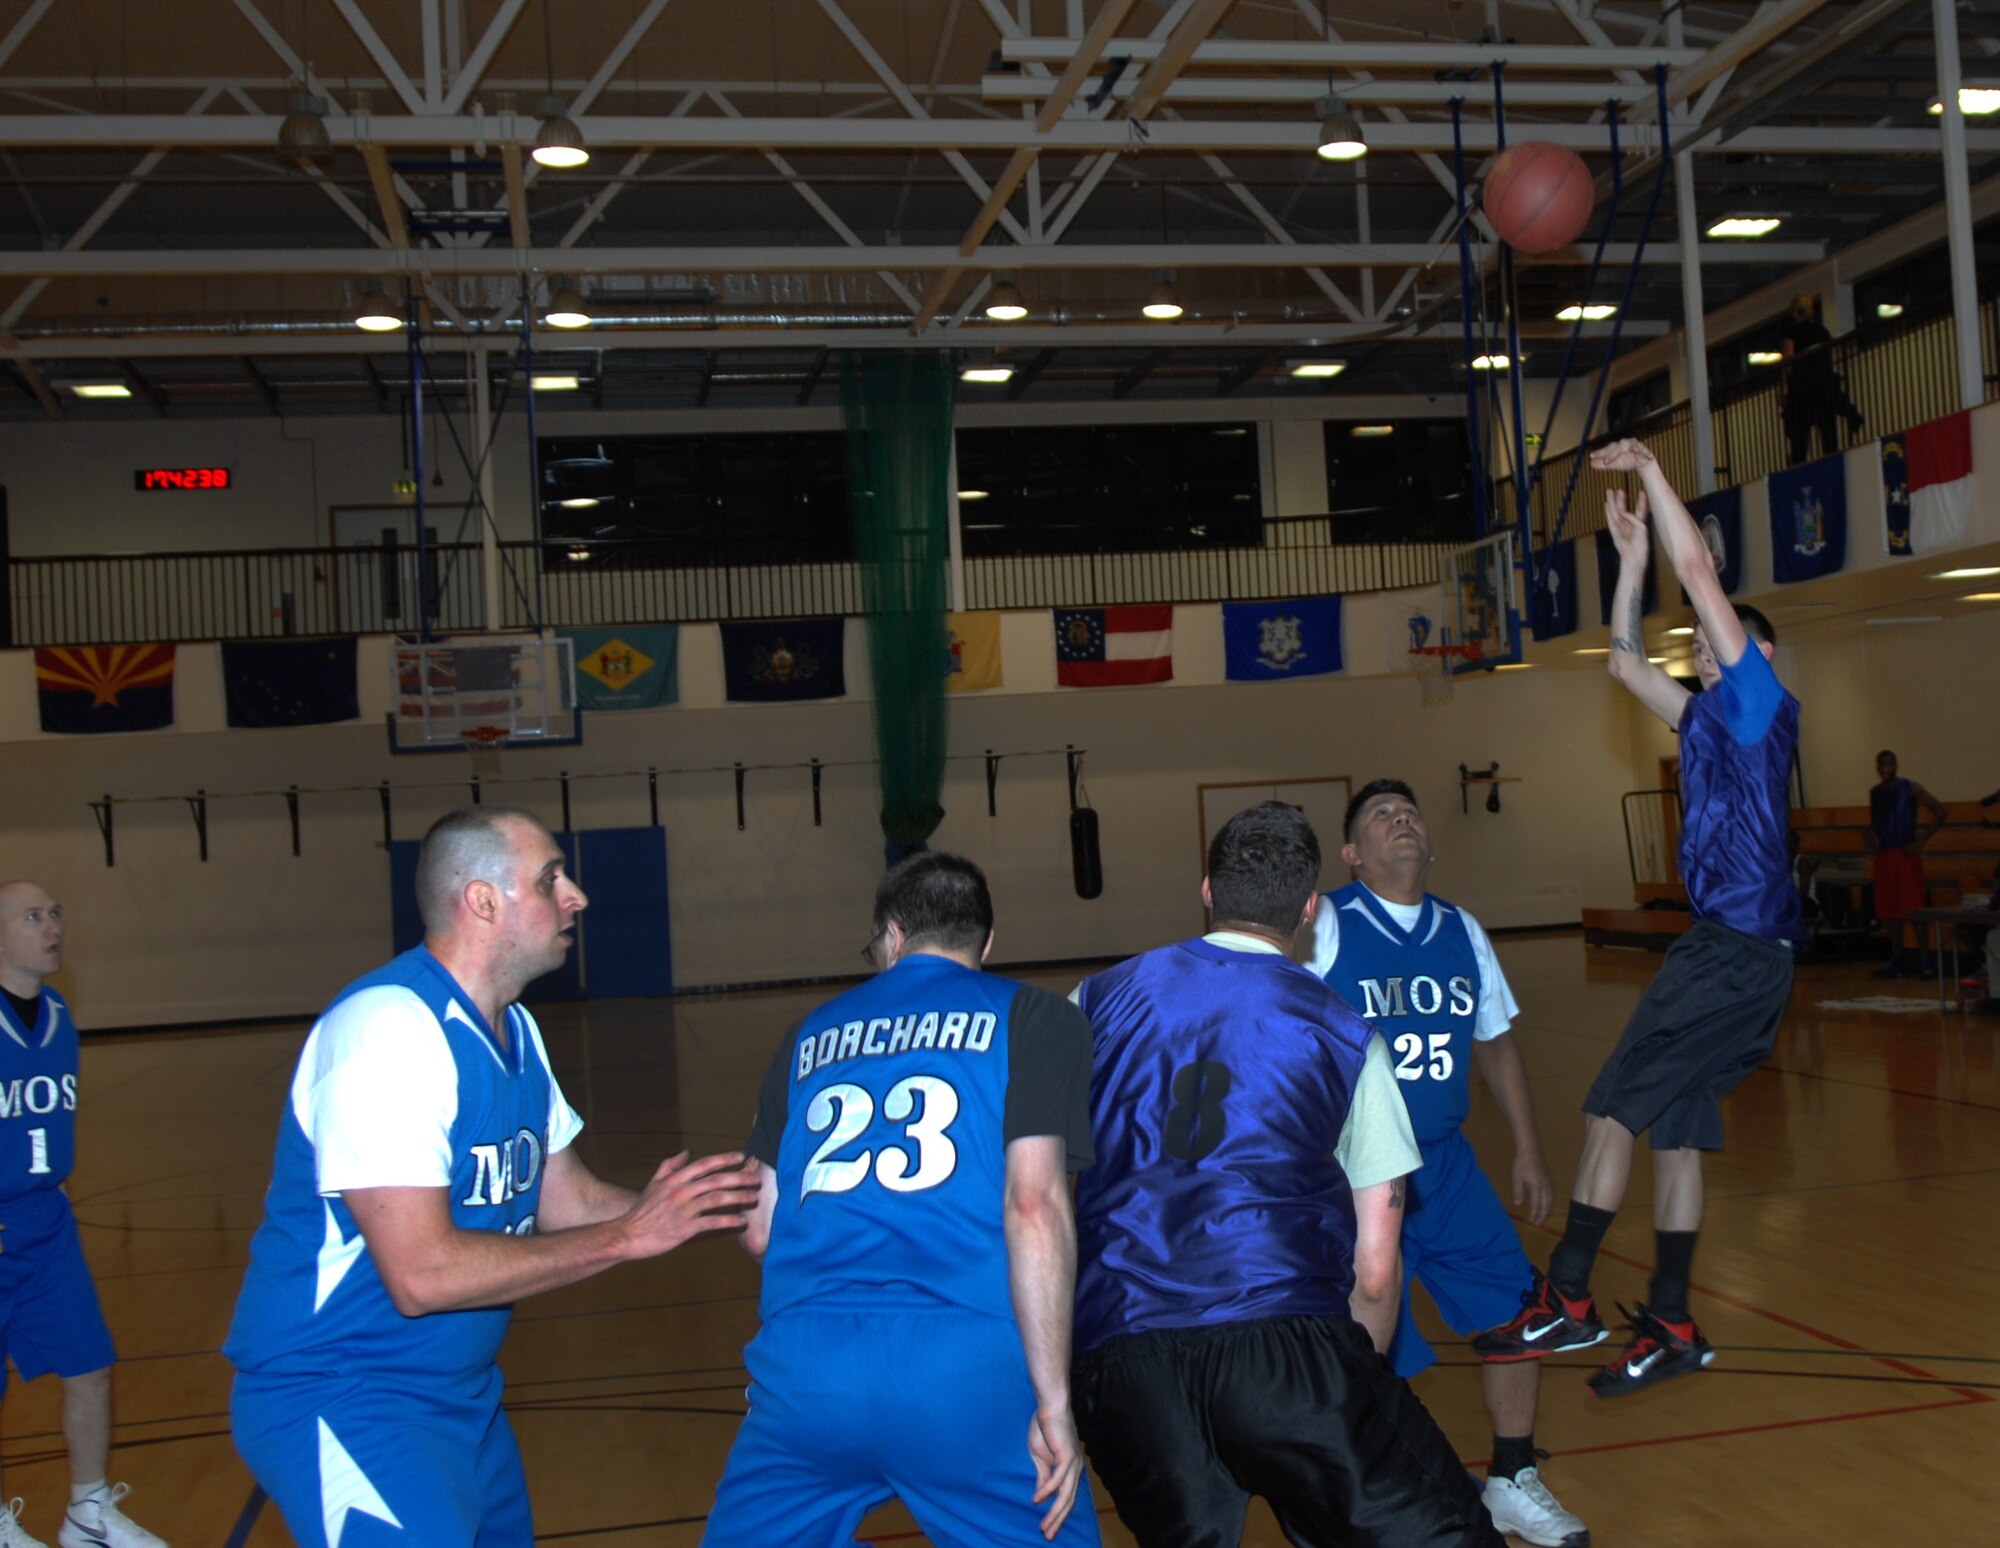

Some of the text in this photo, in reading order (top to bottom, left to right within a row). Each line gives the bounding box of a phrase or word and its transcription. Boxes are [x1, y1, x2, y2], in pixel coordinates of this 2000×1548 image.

[1357, 975, 1474, 1018] MOS
[797, 1010, 998, 1082] BORCHARD
[1393, 1032, 1453, 1081] 25
[0, 1073, 77, 1118] MOS
[1164, 1061, 1230, 1161] 8
[27, 1127, 51, 1174] 1
[462, 1126, 549, 1206] MO
[799, 1074, 959, 1207] 23
